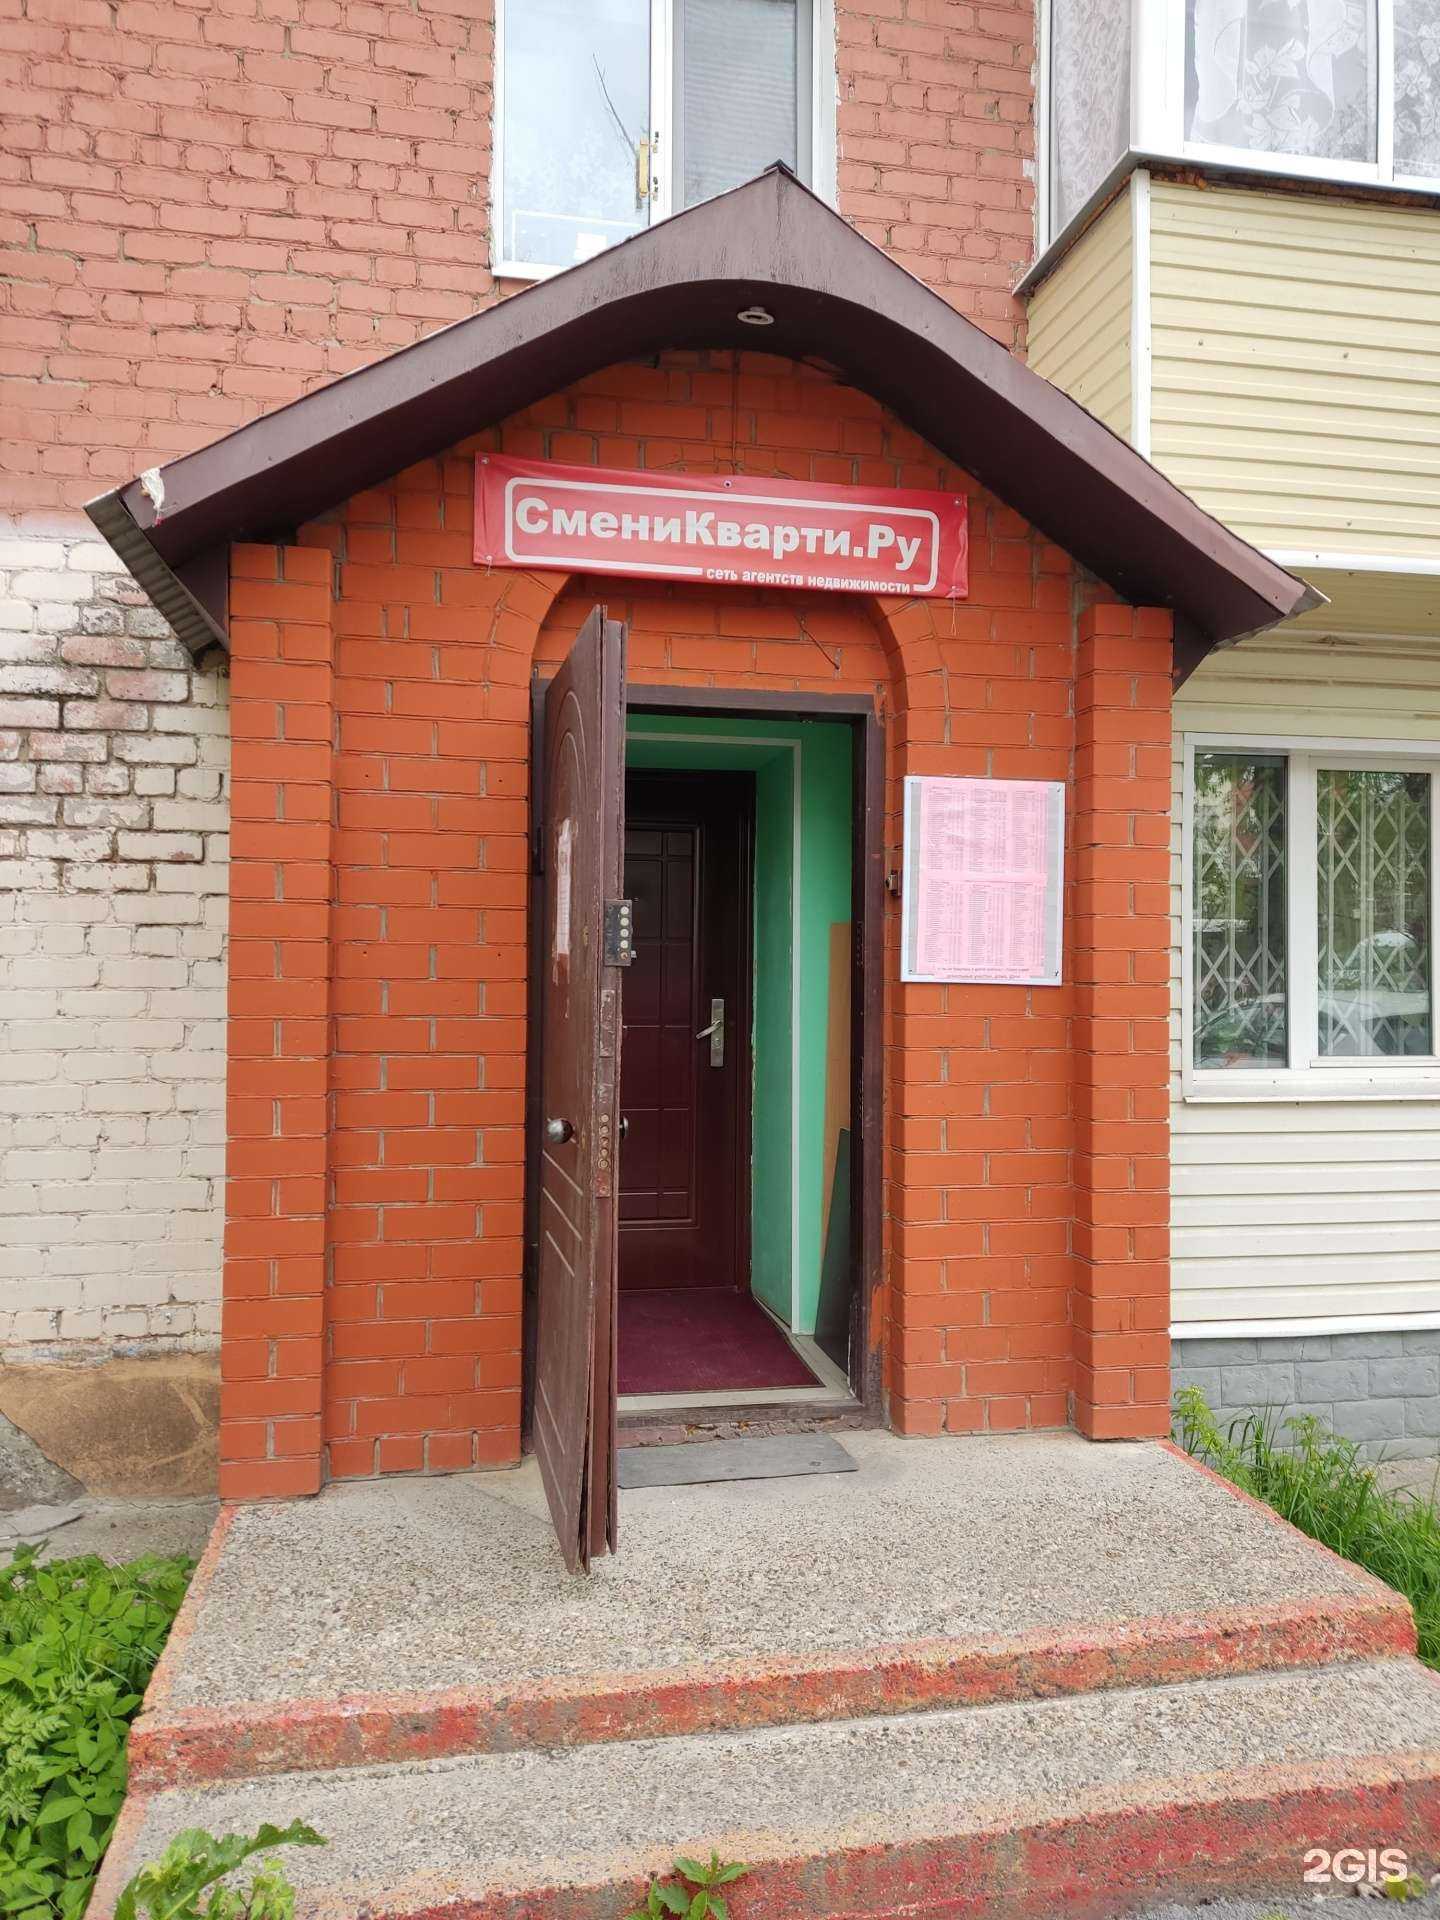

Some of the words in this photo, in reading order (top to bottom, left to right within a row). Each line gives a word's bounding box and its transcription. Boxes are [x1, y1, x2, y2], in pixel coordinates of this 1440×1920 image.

[515, 497, 921, 571] СмениКварти.Ру
[706, 567, 738, 581] сеть
[743, 570, 804, 586] агентств
[808, 575, 910, 593] недвижимости
